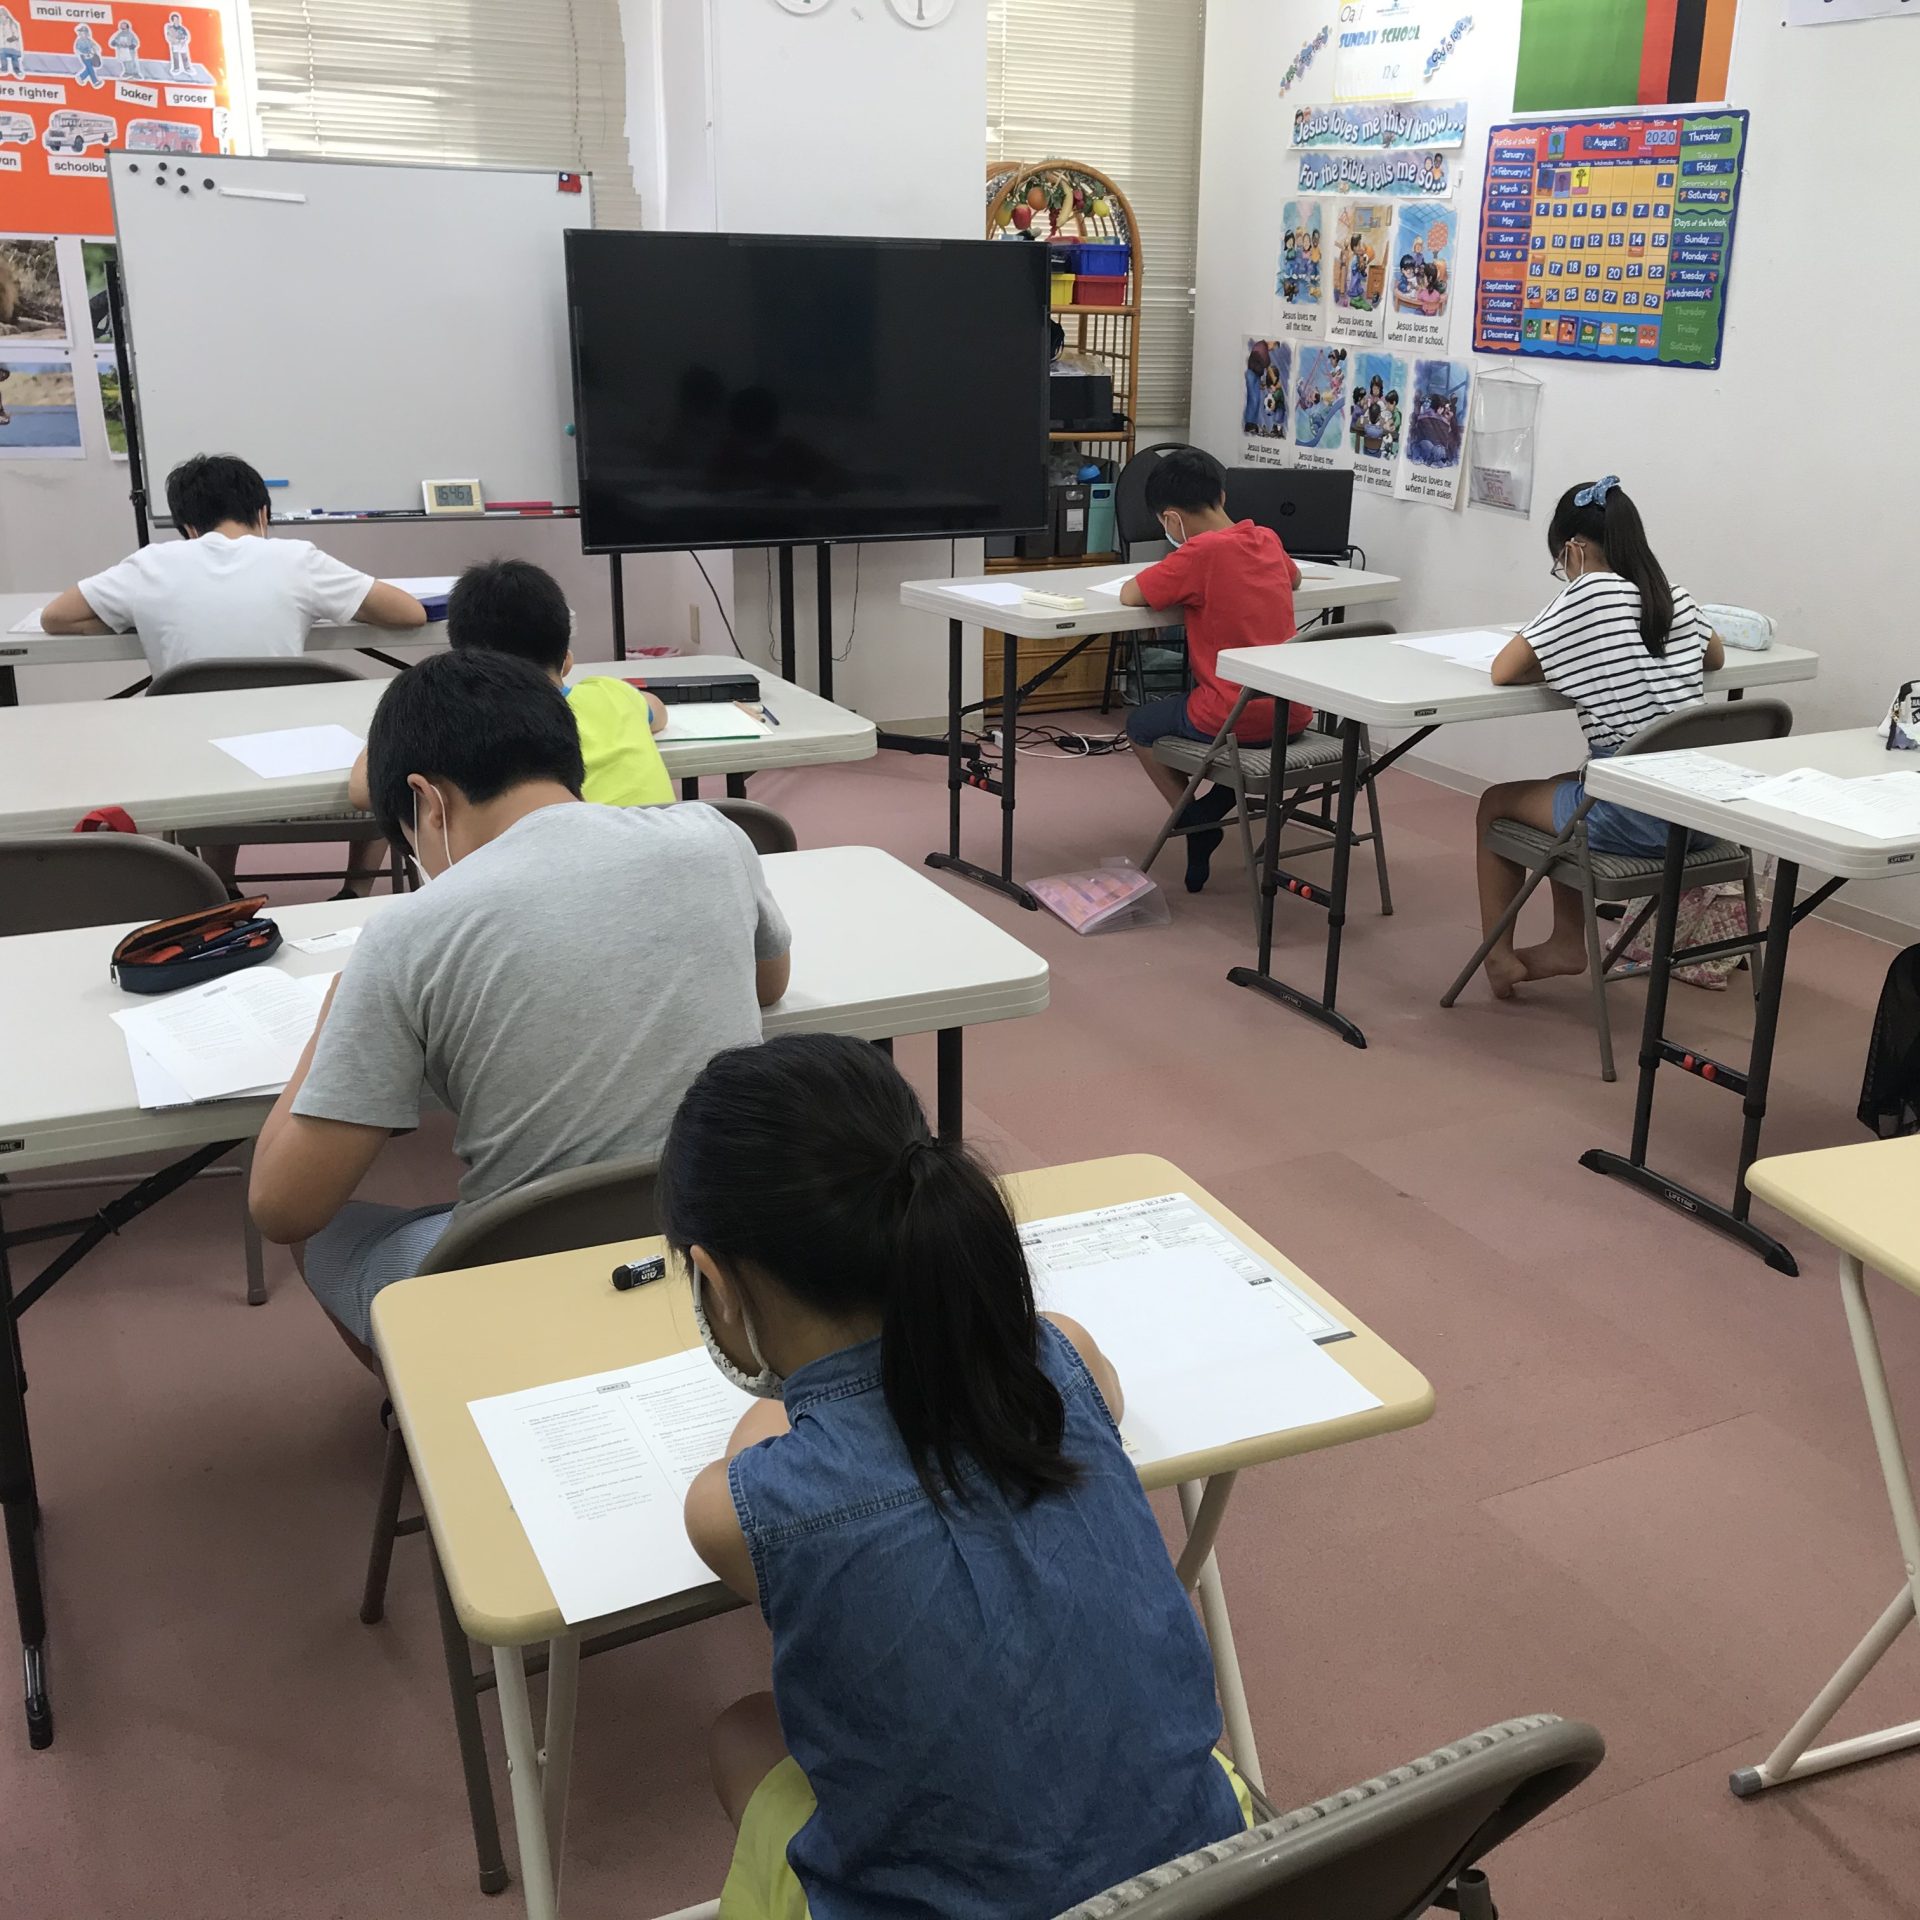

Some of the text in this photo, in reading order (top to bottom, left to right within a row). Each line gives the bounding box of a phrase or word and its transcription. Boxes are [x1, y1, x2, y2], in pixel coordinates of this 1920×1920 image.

[37, 6, 106, 19] mail carrier
[1339, 25, 1420, 48] SUNDAY SCHOOL
[18, 87, 59, 101] fighter
[121, 86, 153, 102] baker
[173, 93, 207, 104] grocer
[1297, 116, 1329, 144] Jesus
[1331, 111, 1359, 143] loves
[1363, 116, 1380, 141] me
[1383, 109, 1407, 136] this
[1646, 132, 1676, 143] 2020
[1689, 130, 1721, 142] Thursday
[1594, 138, 1617, 149] August
[1502, 150, 1525, 160] January
[54, 162, 106, 173] schoolbu
[1499, 167, 1524, 178] February
[1697, 162, 1718, 173] Friday
[1300, 163, 1319, 189] For
[1321, 163, 1339, 187] the
[1341, 158, 1368, 189] Bible
[1370, 163, 1394, 191] tells
[1397, 162, 1417, 181] me
[1500, 184, 1518, 193] March
[1688, 190, 1720, 202] Saturday
[1501, 200, 1516, 211] April
[1540, 204, 1664, 217] 2 3 4 5 6 7 8
[1502, 217, 1514, 227] May
[1674, 219, 1690, 229] Days
[1500, 235, 1514, 243] June
[1535, 234, 1665, 248] 9 10 11 12 13 14 15
[1685, 235, 1710, 245] Sunday
[1499, 251, 1512, 260] July
[1682, 251, 1708, 262] Monday
[1532, 262, 1662, 279] 16 17 18 19 20 21 22
[1680, 271, 1706, 282] Tuesday
[1486, 282, 1516, 292] September
[1566, 289, 1577, 300] 25
[1586, 290, 1597, 301] 26
[1604, 291, 1616, 302] 27
[1625, 293, 1637, 304] 28
[1645, 296, 1658, 307] 29
[1671, 289, 1705, 299] Wednesday
[1489, 299, 1513, 308] October
[1283, 311, 1296, 320] Jesus
[1297, 312, 1308, 321] loves
[1338, 316, 1373, 327] Jesus loves me
[1487, 314, 1514, 324] November
[1331, 327, 1344, 335] when
[1396, 321, 1439, 334] Jesus loves me
[1388, 332, 1403, 342] when
[1418, 336, 1424, 344] at
[1488, 330, 1514, 339] December
[1248, 443, 1260, 452] Jesus
[1261, 444, 1272, 453] loves
[1299, 452, 1312, 462] Jesus
[1314, 454, 1324, 464] loves
[1353, 462, 1368, 472] Jesus
[1368, 464, 1381, 474] loves
[1411, 473, 1452, 488] Jesus loves me
[1405, 484, 1422, 494] when
[1426, 488, 1436, 496] am
